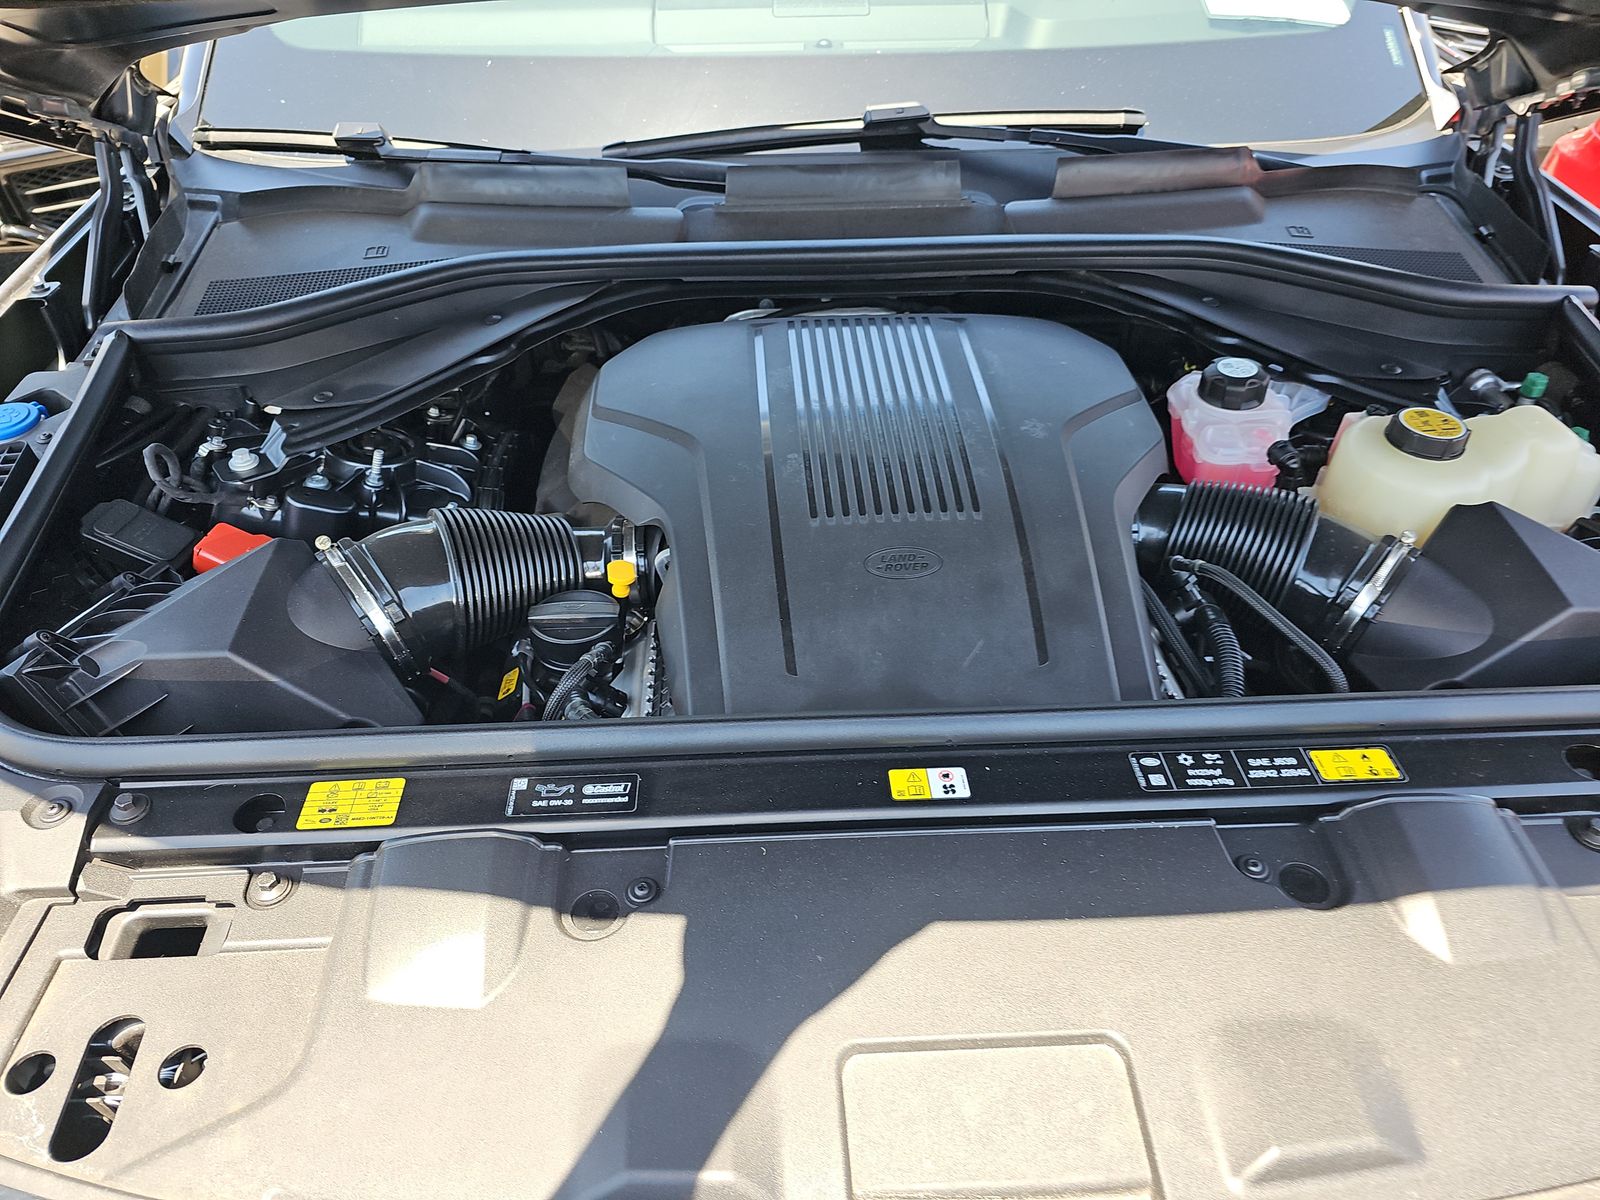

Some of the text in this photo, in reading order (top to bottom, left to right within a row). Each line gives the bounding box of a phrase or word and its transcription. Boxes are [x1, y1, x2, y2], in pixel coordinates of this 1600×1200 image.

[1247, 757, 1272, 767] SAE
[590, 783, 626, 794] Castrol
[582, 796, 629, 804] recommended
